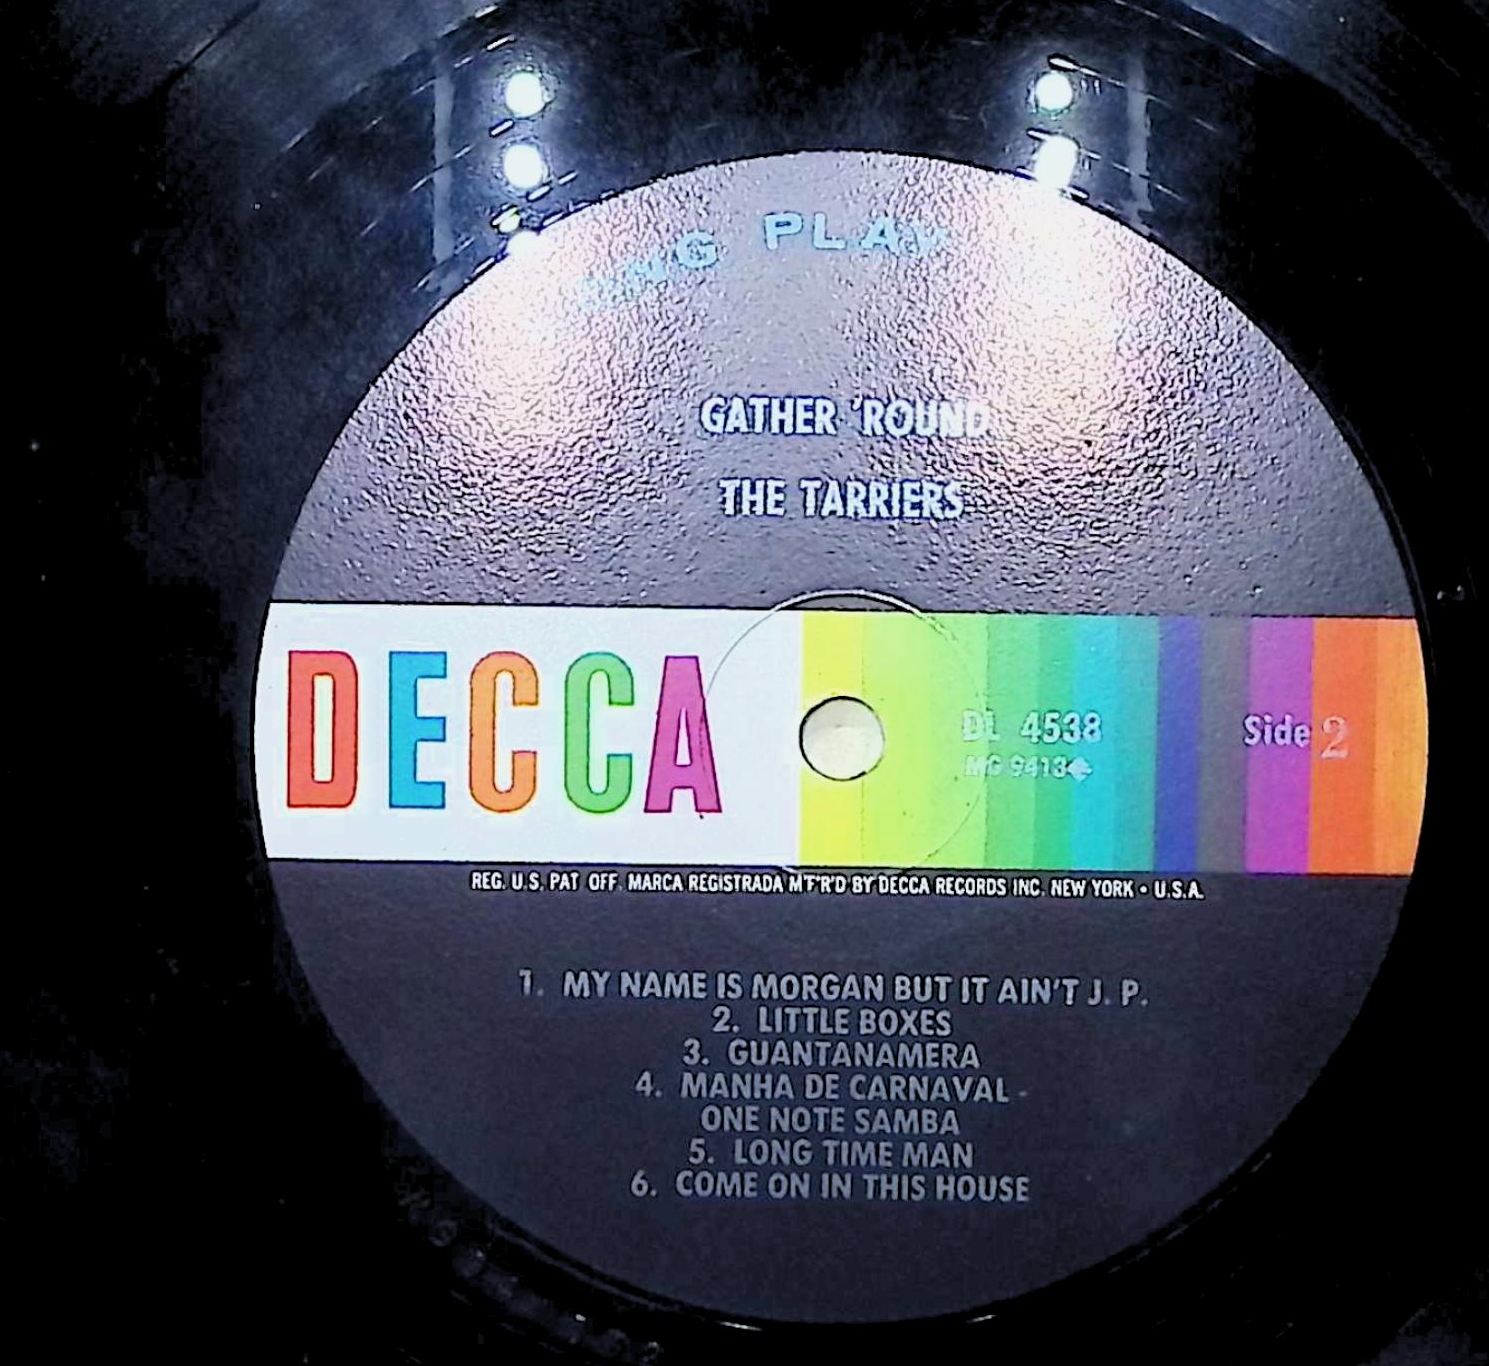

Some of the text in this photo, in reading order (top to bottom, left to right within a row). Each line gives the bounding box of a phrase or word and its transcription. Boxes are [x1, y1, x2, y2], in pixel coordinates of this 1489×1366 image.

[698, 394, 838, 436] GATHER
[717, 476, 964, 520] THE TARRIERS
[286, 650, 723, 814] DECCA
[961, 709, 1104, 745] DL 4538
[1243, 713, 1349, 759] Side 2
[627, 873, 683, 892] MARCA
[687, 874, 784, 894] REGISTRADA
[851, 875, 874, 895] BY
[877, 875, 931, 896] DECCA
[935, 876, 1007, 896] RECORDS
[1050, 879, 1087, 898] NEW
[1091, 879, 1135, 899] YORK
[563, 971, 611, 999] MY
[620, 971, 708, 999] NAME
[716, 972, 744, 999] IS
[751, 973, 884, 1002] MORGAN
[894, 975, 953, 1002] BUT
[961, 976, 990, 1004] IT
[997, 976, 1080, 1006] AIN'T
[712, 1005, 953, 1036] 2. LITTLE BOXES
[682, 1038, 981, 1069] 3. GUANTANAMERA
[635, 1071, 663, 1098] 4.
[680, 1072, 795, 1100] MANHA
[804, 1073, 840, 1100] DE
[849, 1074, 1010, 1104] CARNAVAL
[700, 1105, 961, 1136] ONE NOTE SAMBA
[688, 1138, 974, 1169] 5. LONG TIME MAN
[630, 1169, 1031, 1203] 6. COME ON IN THIS HOUSE
